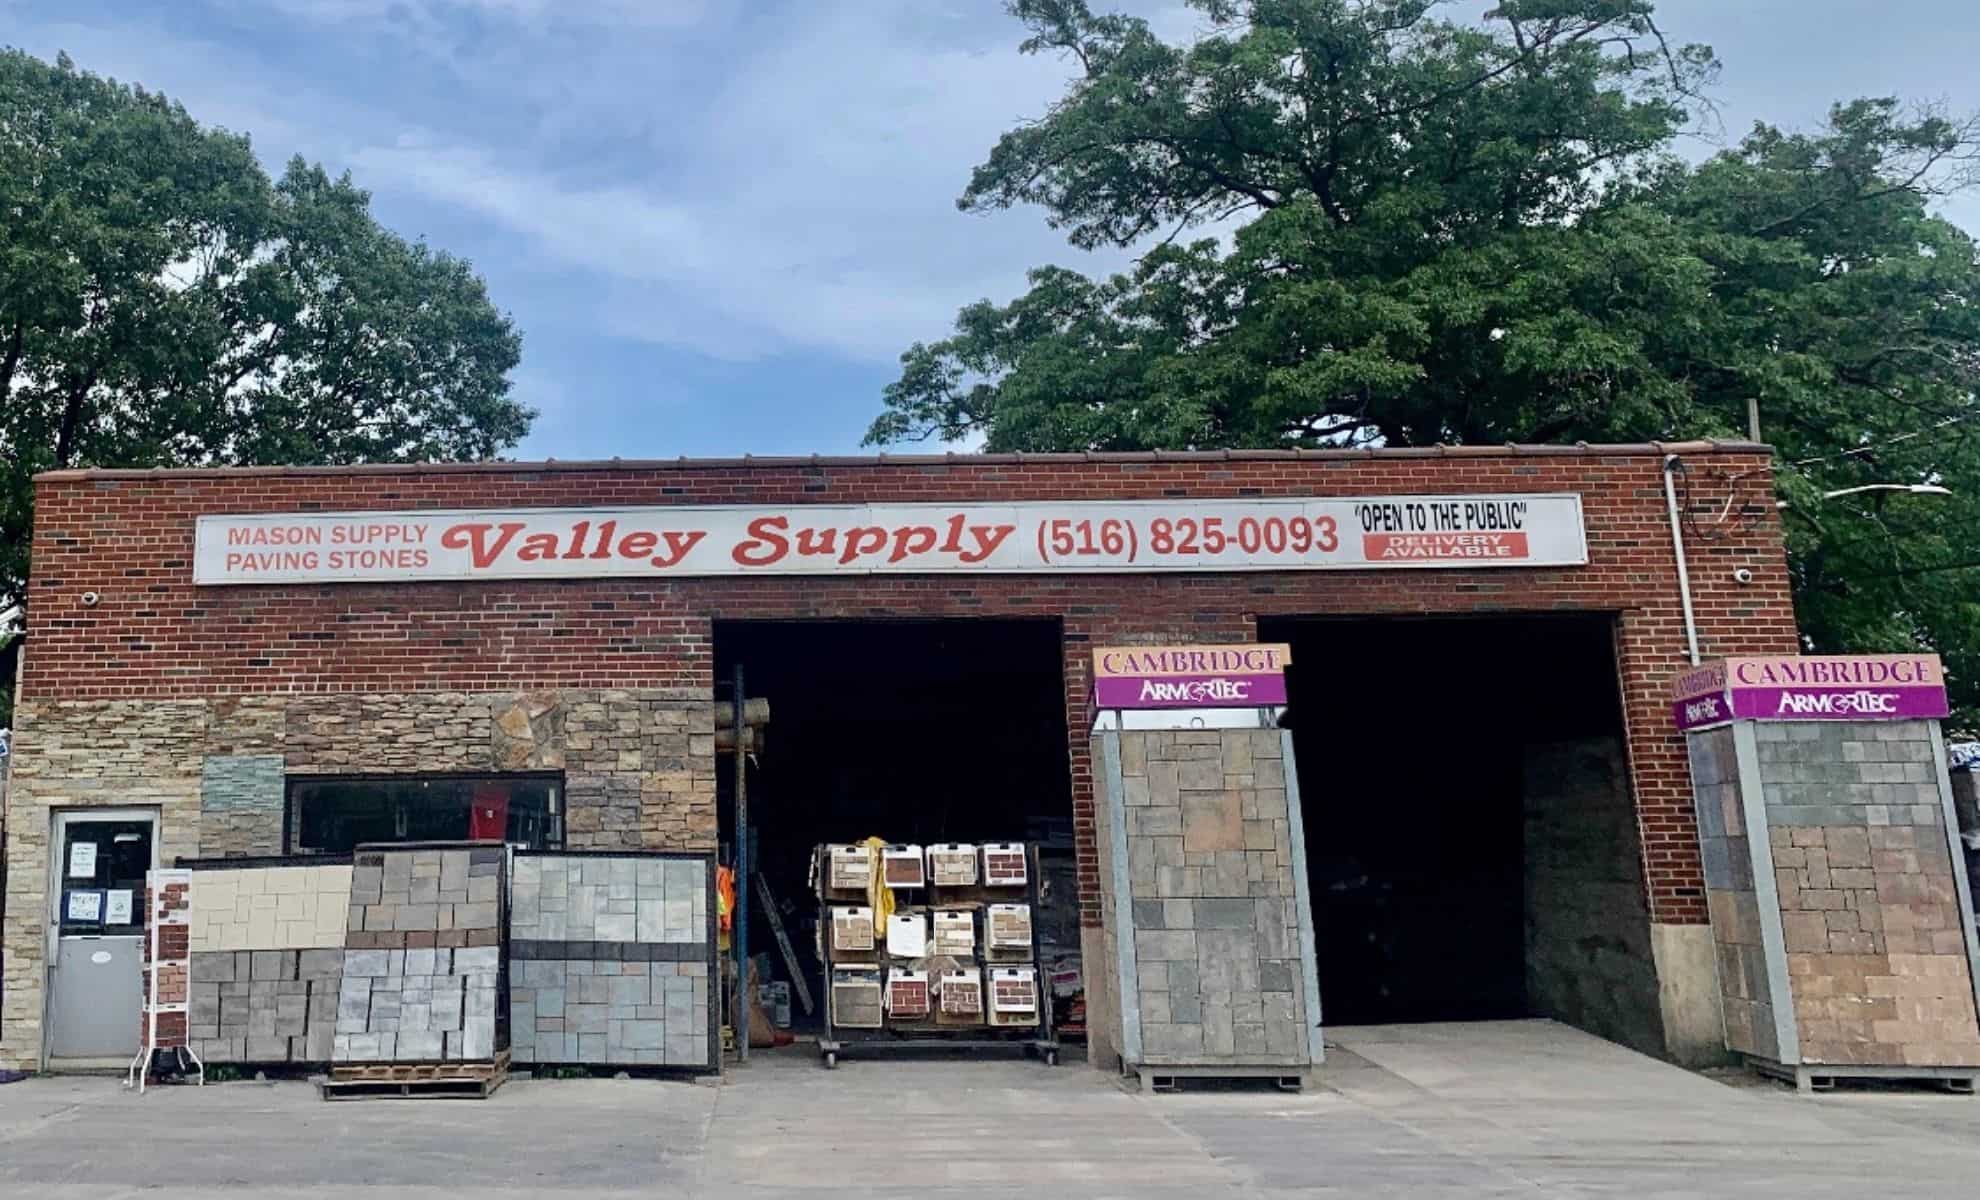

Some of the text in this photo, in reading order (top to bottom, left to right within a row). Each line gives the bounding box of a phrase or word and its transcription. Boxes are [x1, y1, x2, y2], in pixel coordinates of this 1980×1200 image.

[1406, 503, 1426, 532] TO
[1430, 503, 1461, 531] THE
[227, 524, 428, 546] MASON SUPPLY
[440, 513, 1016, 569] Valley Supply
[1037, 516, 1339, 564] (516) 825-0093
[1389, 535, 1503, 547] DELIVERY
[226, 549, 429, 571] PAVING STONES
[1381, 546, 1512, 558] AVAILABLE
[1103, 649, 1282, 674] CAMBRIDGE
[1736, 660, 1930, 685] CAMBRIDGE
